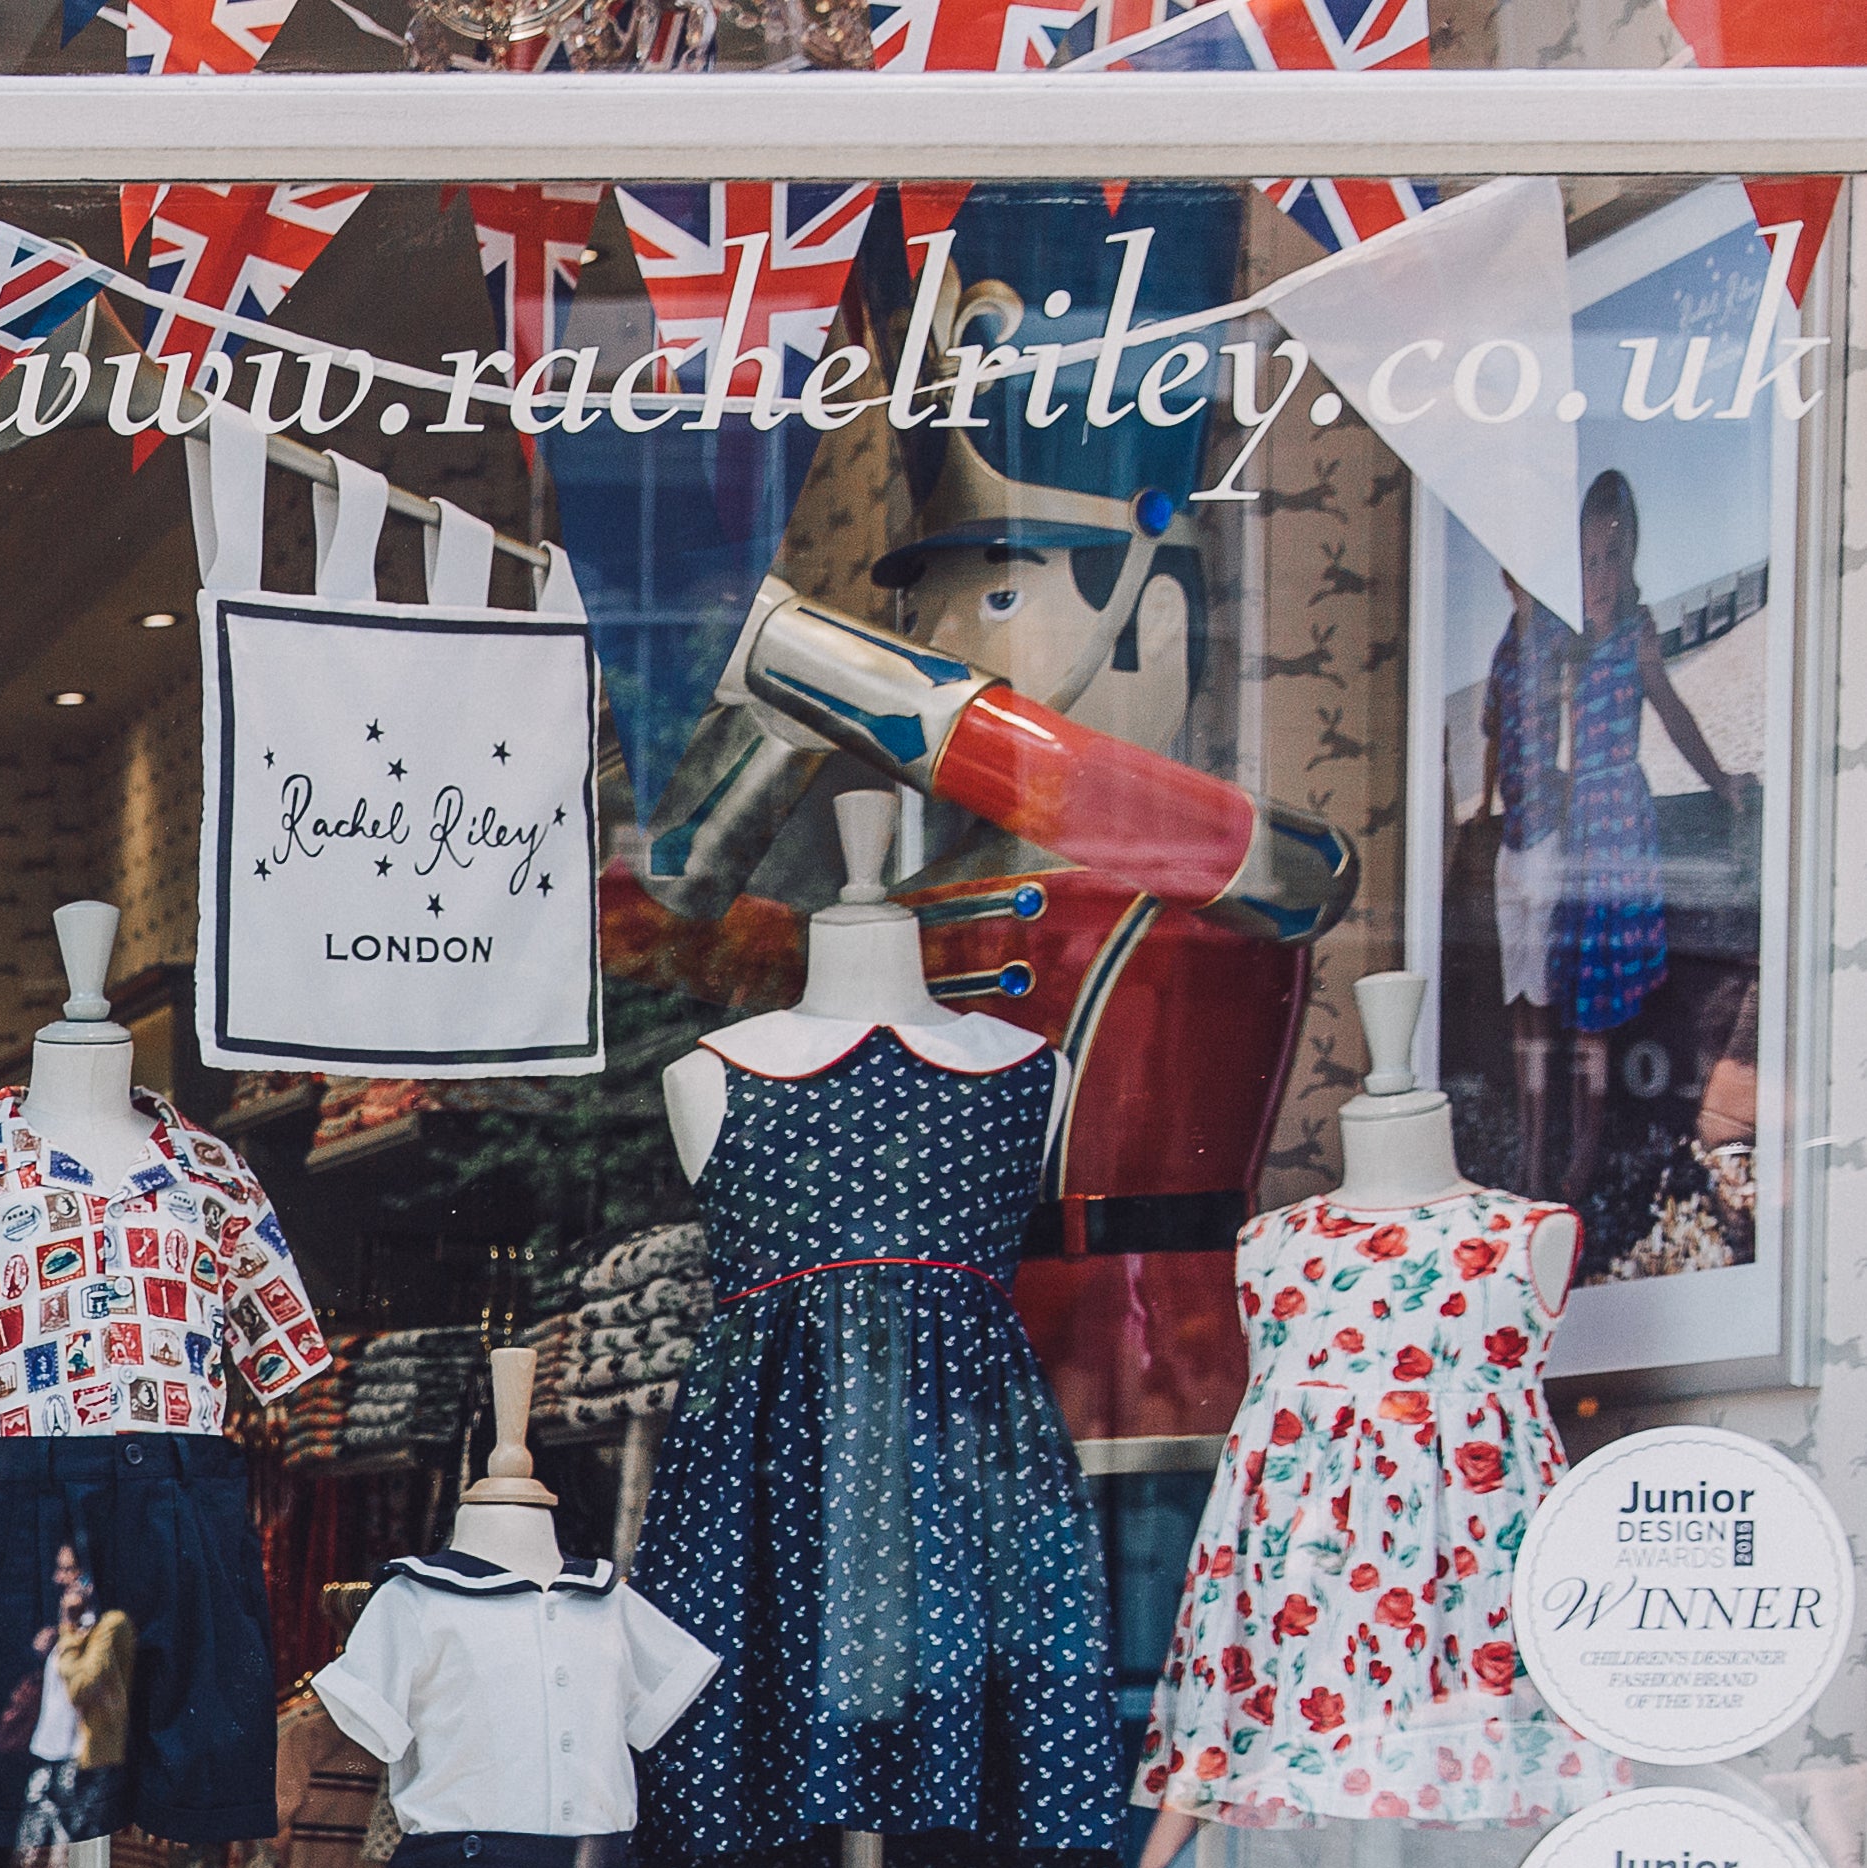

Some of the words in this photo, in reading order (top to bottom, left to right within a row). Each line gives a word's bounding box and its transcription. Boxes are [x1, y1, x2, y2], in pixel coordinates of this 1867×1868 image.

[273, 773, 411, 865] Rachel
[414, 785, 549, 896] Riley
[324, 932, 494, 964] LONDON
[1619, 1480, 1755, 1514] Junior
[1617, 1520, 1727, 1543] DESIGN
[1614, 1547, 1726, 1569] AWARDS
[1541, 1575, 1825, 1632] WINNER
[1692, 1650, 1787, 1666] DESIGNER
[1608, 1672, 1690, 1688] FASHION
[1692, 1672, 1758, 1688] BRAND
[1625, 1694, 1652, 1709] OF
[1654, 1694, 1693, 1709] THE
[1696, 1694, 1745, 1709] YEAR
